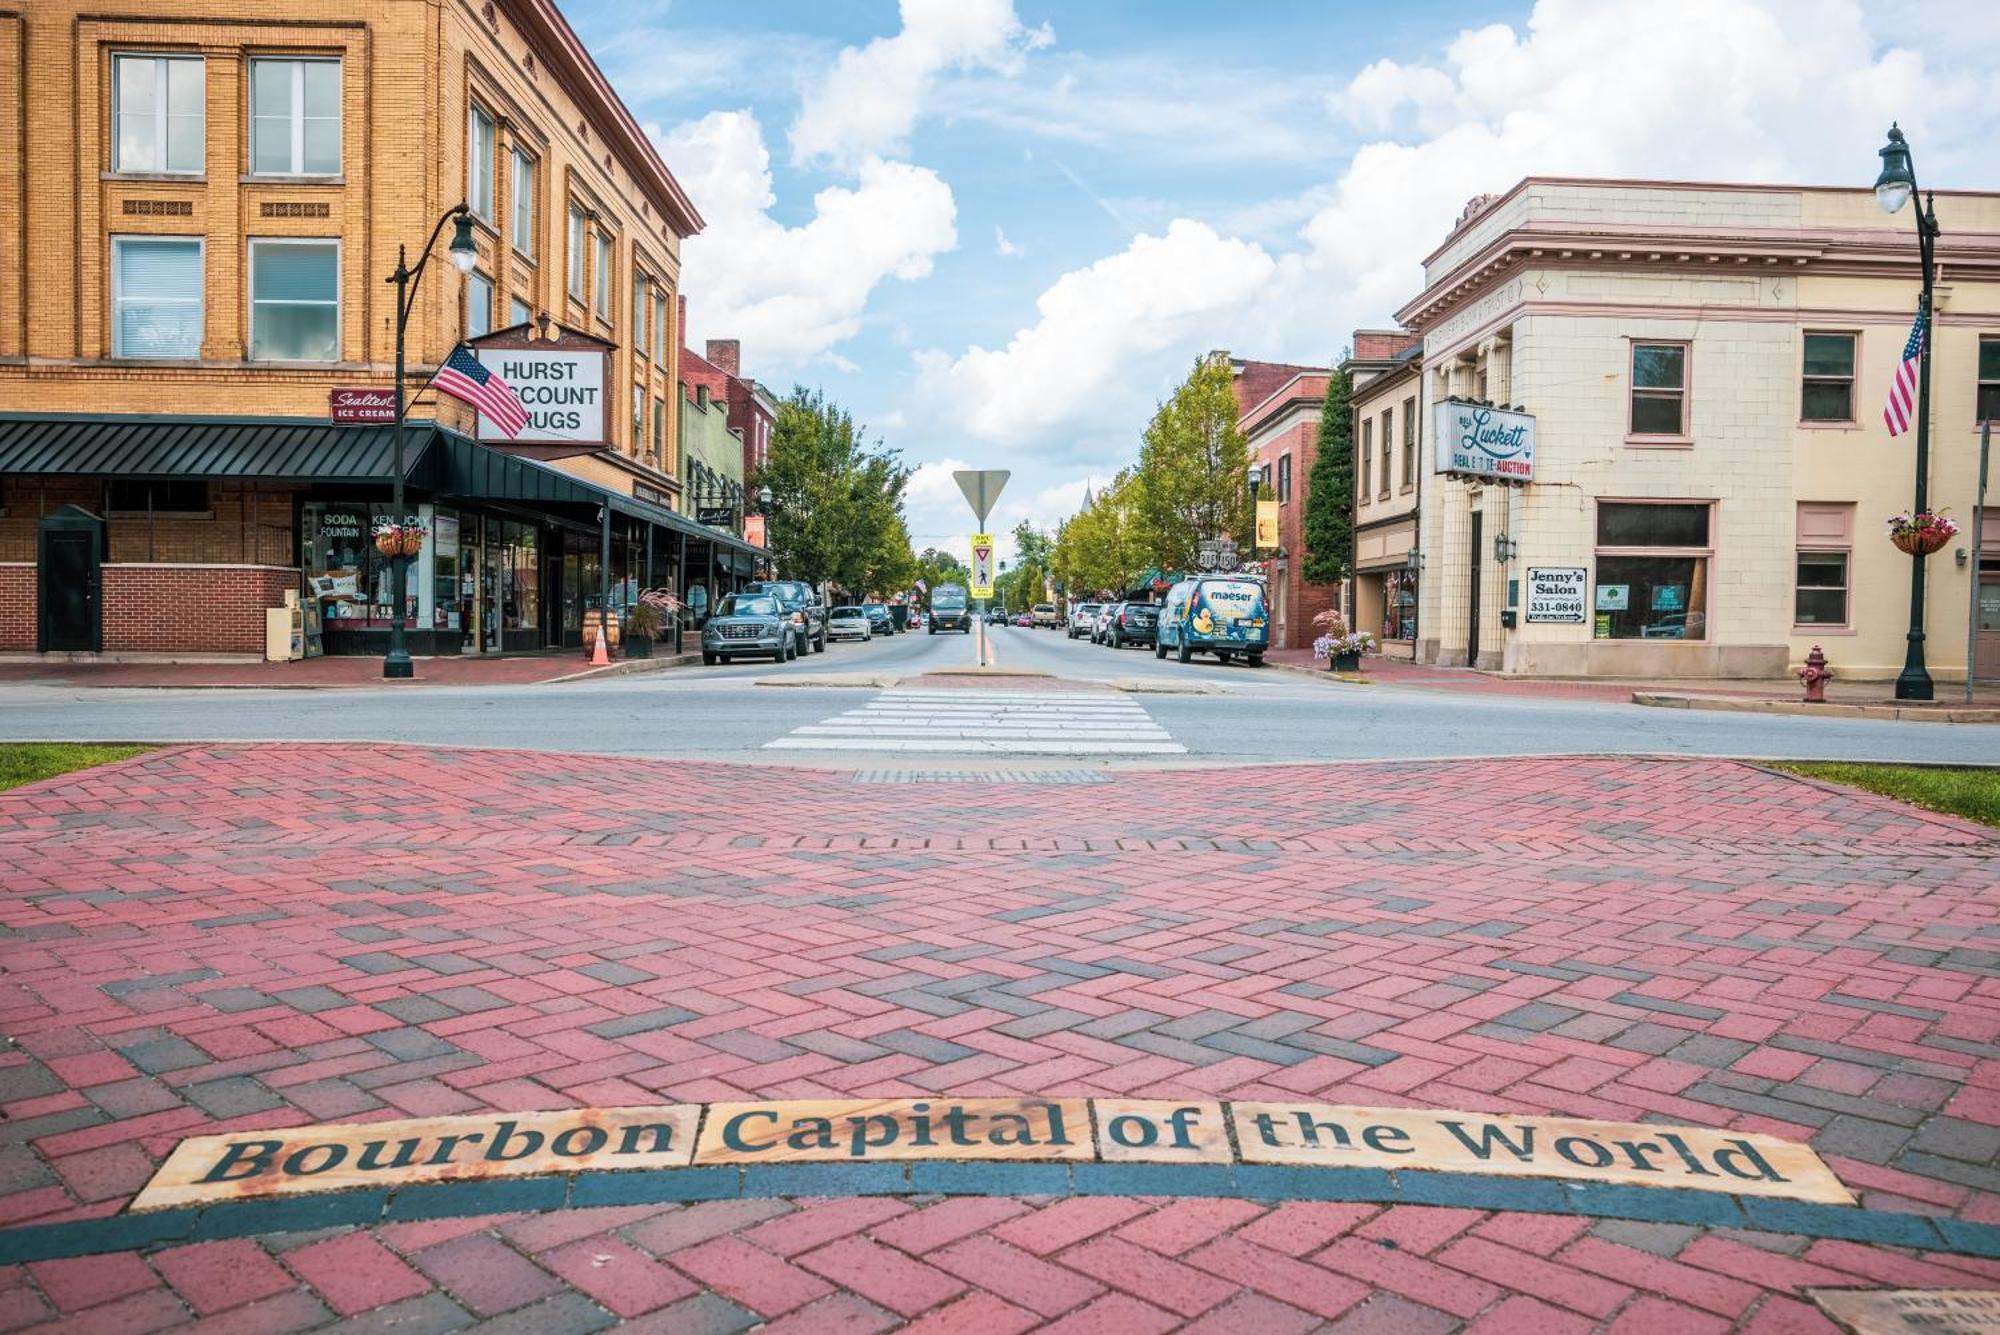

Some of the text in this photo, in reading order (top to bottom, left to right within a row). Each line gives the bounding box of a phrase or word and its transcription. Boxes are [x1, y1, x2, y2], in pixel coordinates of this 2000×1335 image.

[504, 362, 578, 380] HURST
[333, 393, 396, 407] Sealtest
[358, 410, 395, 418] CREAM
[1461, 409, 1527, 458] Luckett
[324, 515, 357, 525] SODA
[321, 527, 359, 537] FOUNTAIN
[1531, 571, 1584, 583] Jenny's
[1535, 584, 1577, 594] Salon
[1211, 592, 1252, 601] maeser
[1531, 603, 1582, 612] 331-0840
[191, 1103, 1793, 1185] Bourbon Capital of the World
